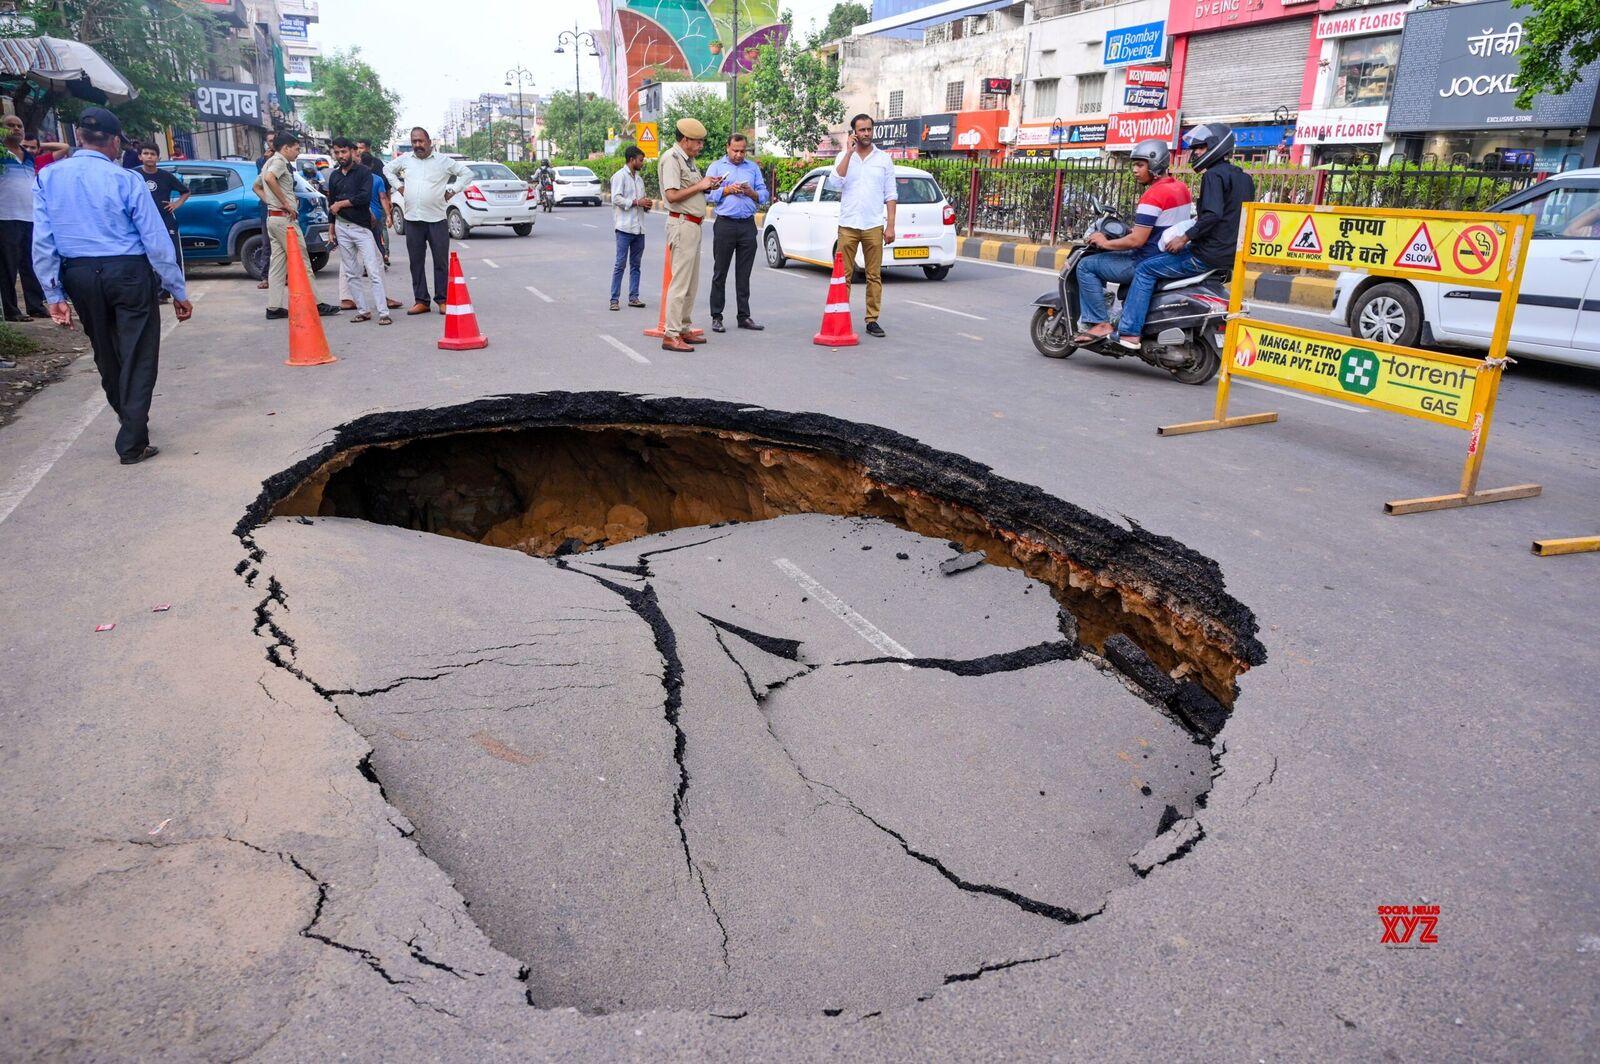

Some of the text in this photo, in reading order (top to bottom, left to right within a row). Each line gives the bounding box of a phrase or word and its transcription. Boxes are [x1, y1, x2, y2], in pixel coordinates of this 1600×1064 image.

[1195, 0, 1240, 19] DYEING
[1318, 18, 1356, 35] KANAK
[1124, 28, 1160, 45] Bombay
[1467, 22, 1527, 57] जॉकी
[1121, 43, 1154, 60] Dyeing
[1129, 69, 1168, 84] Raymond
[1439, 73, 1522, 97] JOCKE
[197, 86, 258, 118] शराब
[1119, 113, 1173, 143] Raymond
[1486, 115, 1514, 123] EXCLUSIVE
[1297, 123, 1383, 138] KANAK FLORIST
[1339, 217, 1386, 238] कृपया
[1250, 243, 1283, 256] STOP
[1328, 240, 1356, 261] धीरे
[1413, 243, 1427, 252] GO
[1405, 254, 1433, 263] SLOW
[1259, 334, 1342, 361] MANGAL PETRO
[1257, 349, 1337, 377] INFRA PVT. LTD.
[1382, 356, 1476, 389] torrent
[1420, 396, 1458, 416] GAS
